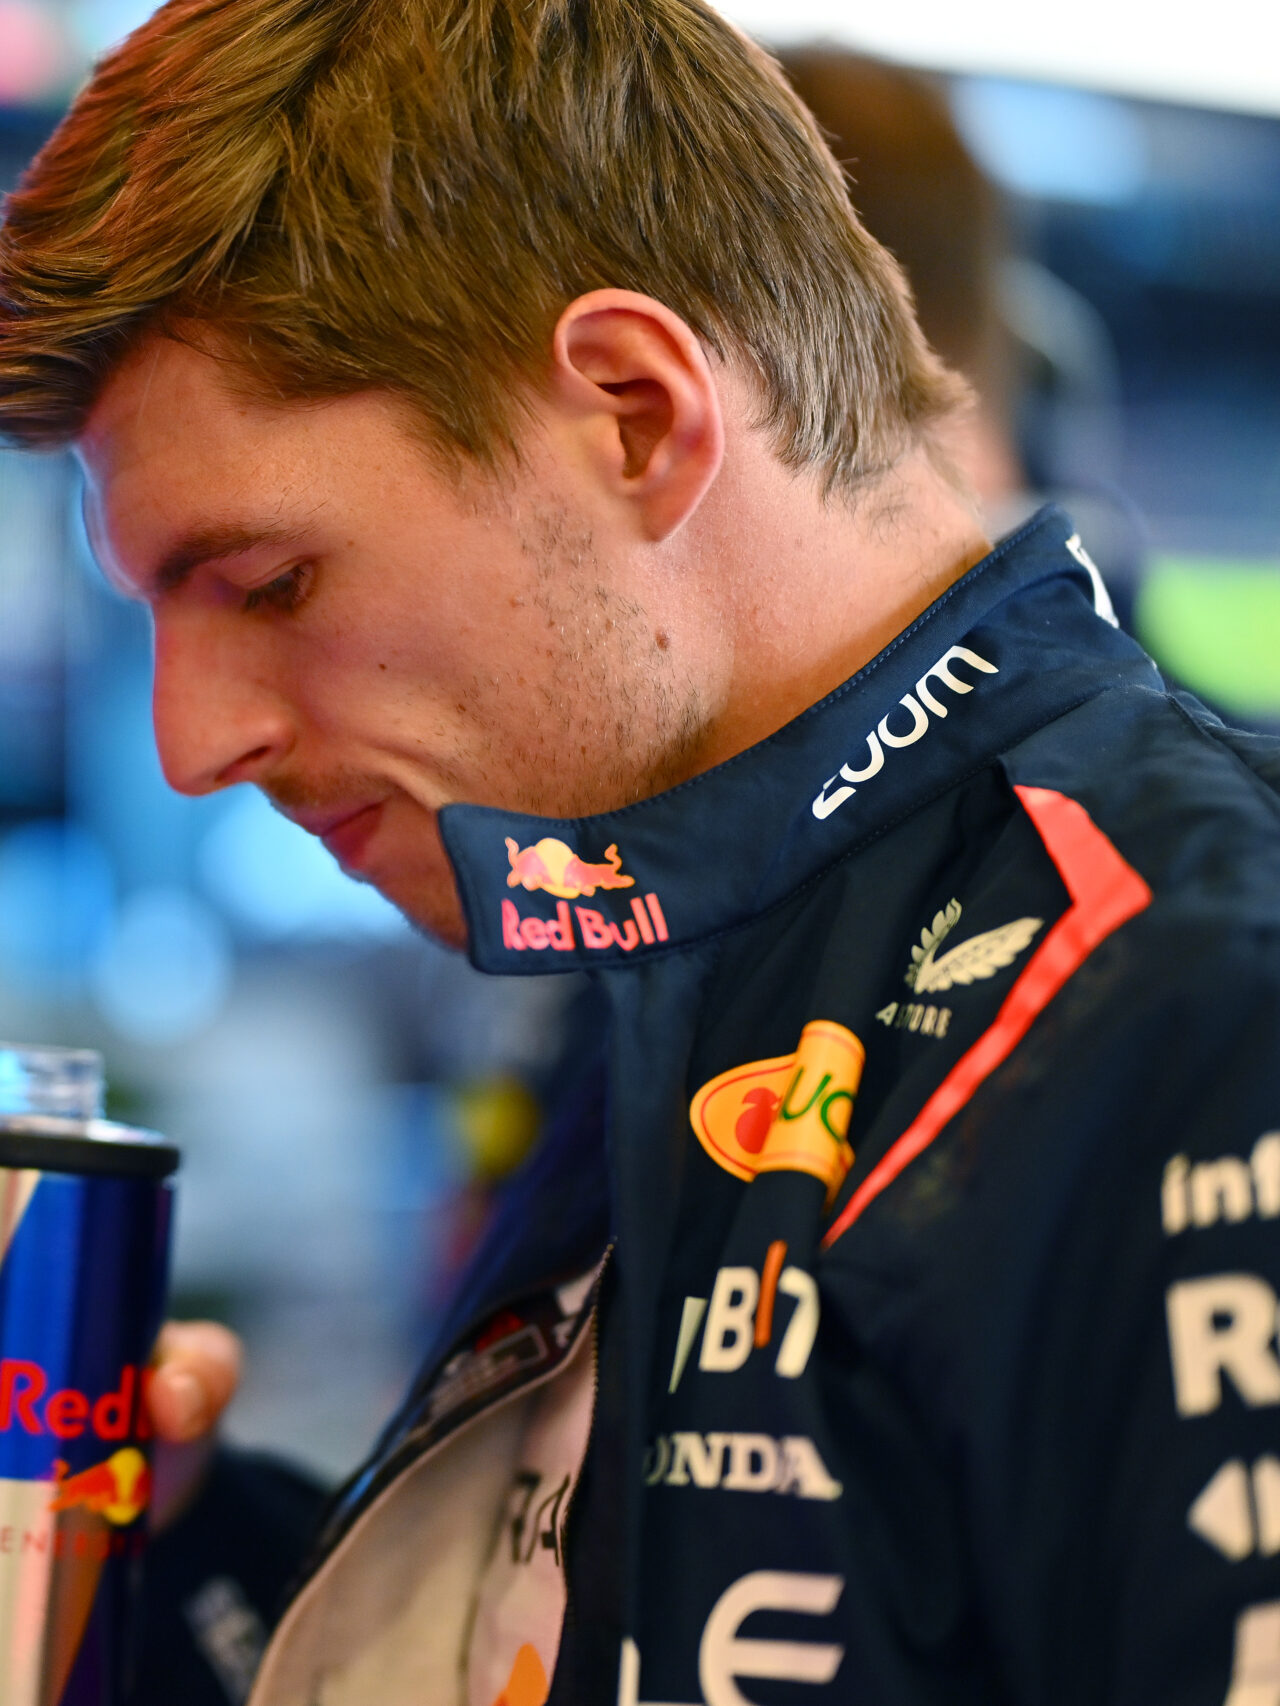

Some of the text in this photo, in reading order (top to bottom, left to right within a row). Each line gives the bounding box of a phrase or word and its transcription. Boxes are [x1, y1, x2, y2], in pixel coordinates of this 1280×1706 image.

[501, 892, 669, 951] Red Bull
[1166, 1274, 1280, 1417] R
